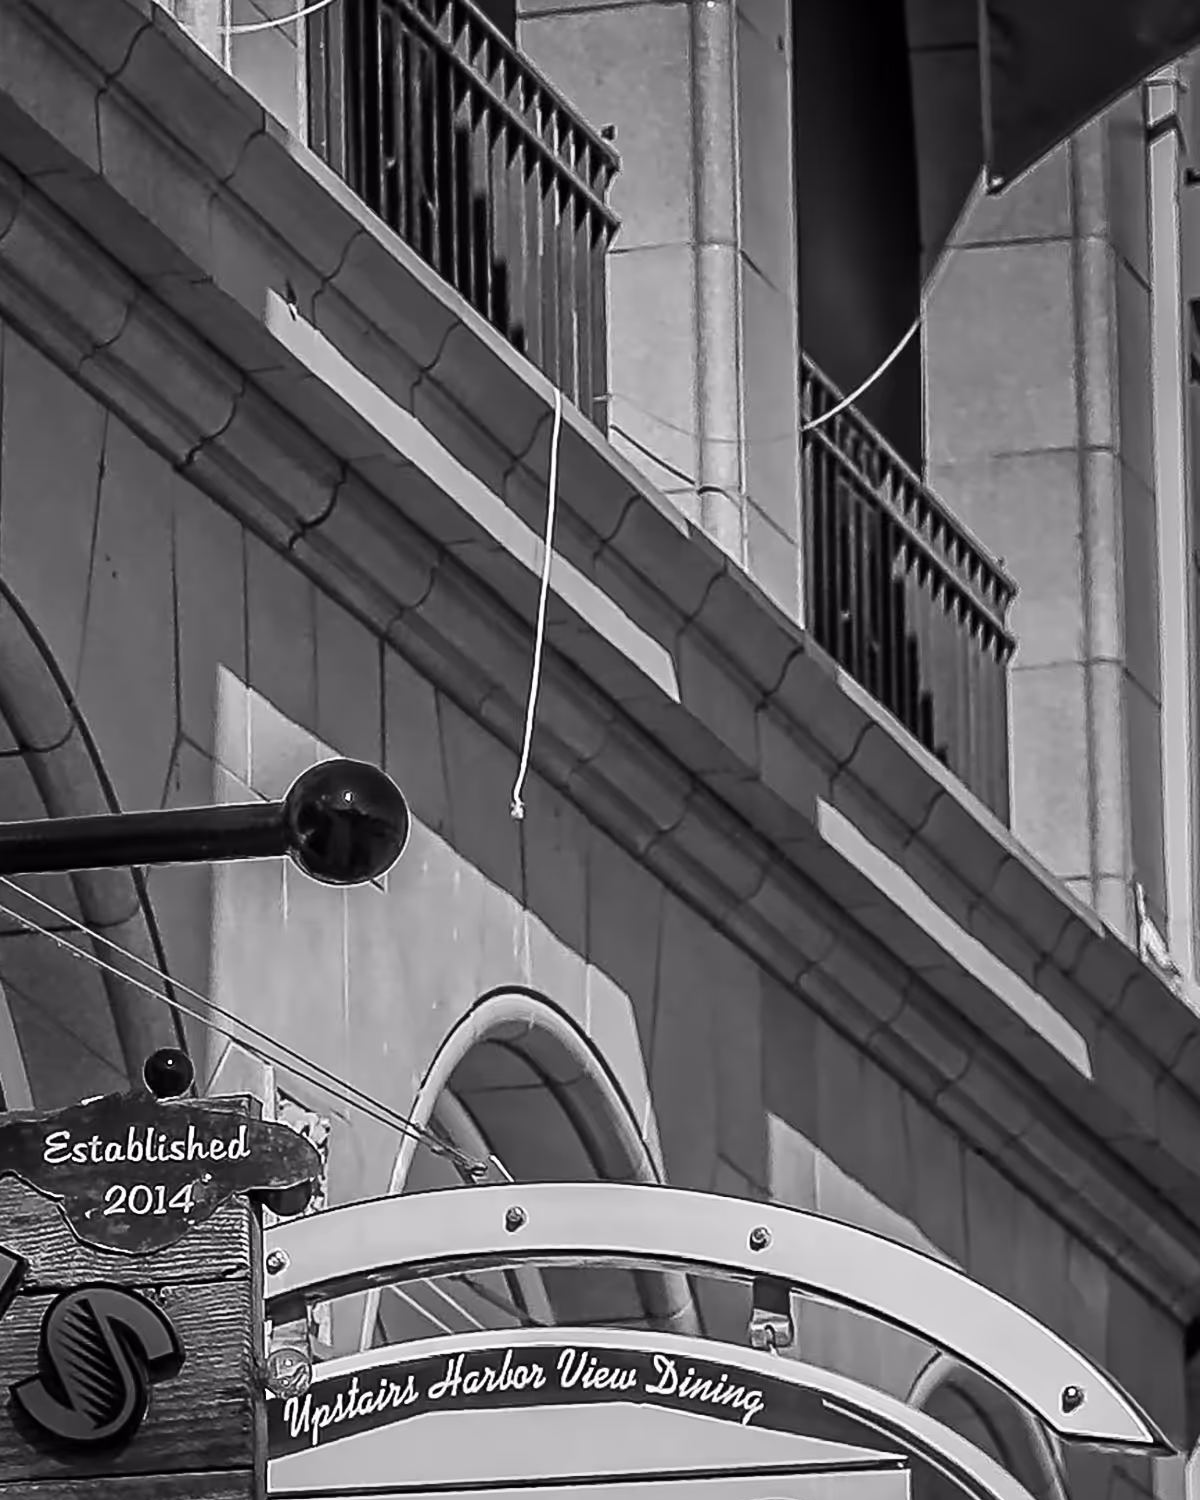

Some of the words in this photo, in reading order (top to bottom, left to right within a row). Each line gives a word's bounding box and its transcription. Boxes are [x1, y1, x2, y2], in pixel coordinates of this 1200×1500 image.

[43, 1125, 251, 1166] Established
[103, 1183, 196, 1217] 2014
[283, 1374, 420, 1444] Upstairs
[427, 1355, 545, 1399] Harbor
[556, 1349, 638, 1392] View
[644, 1355, 766, 1425] Dining
